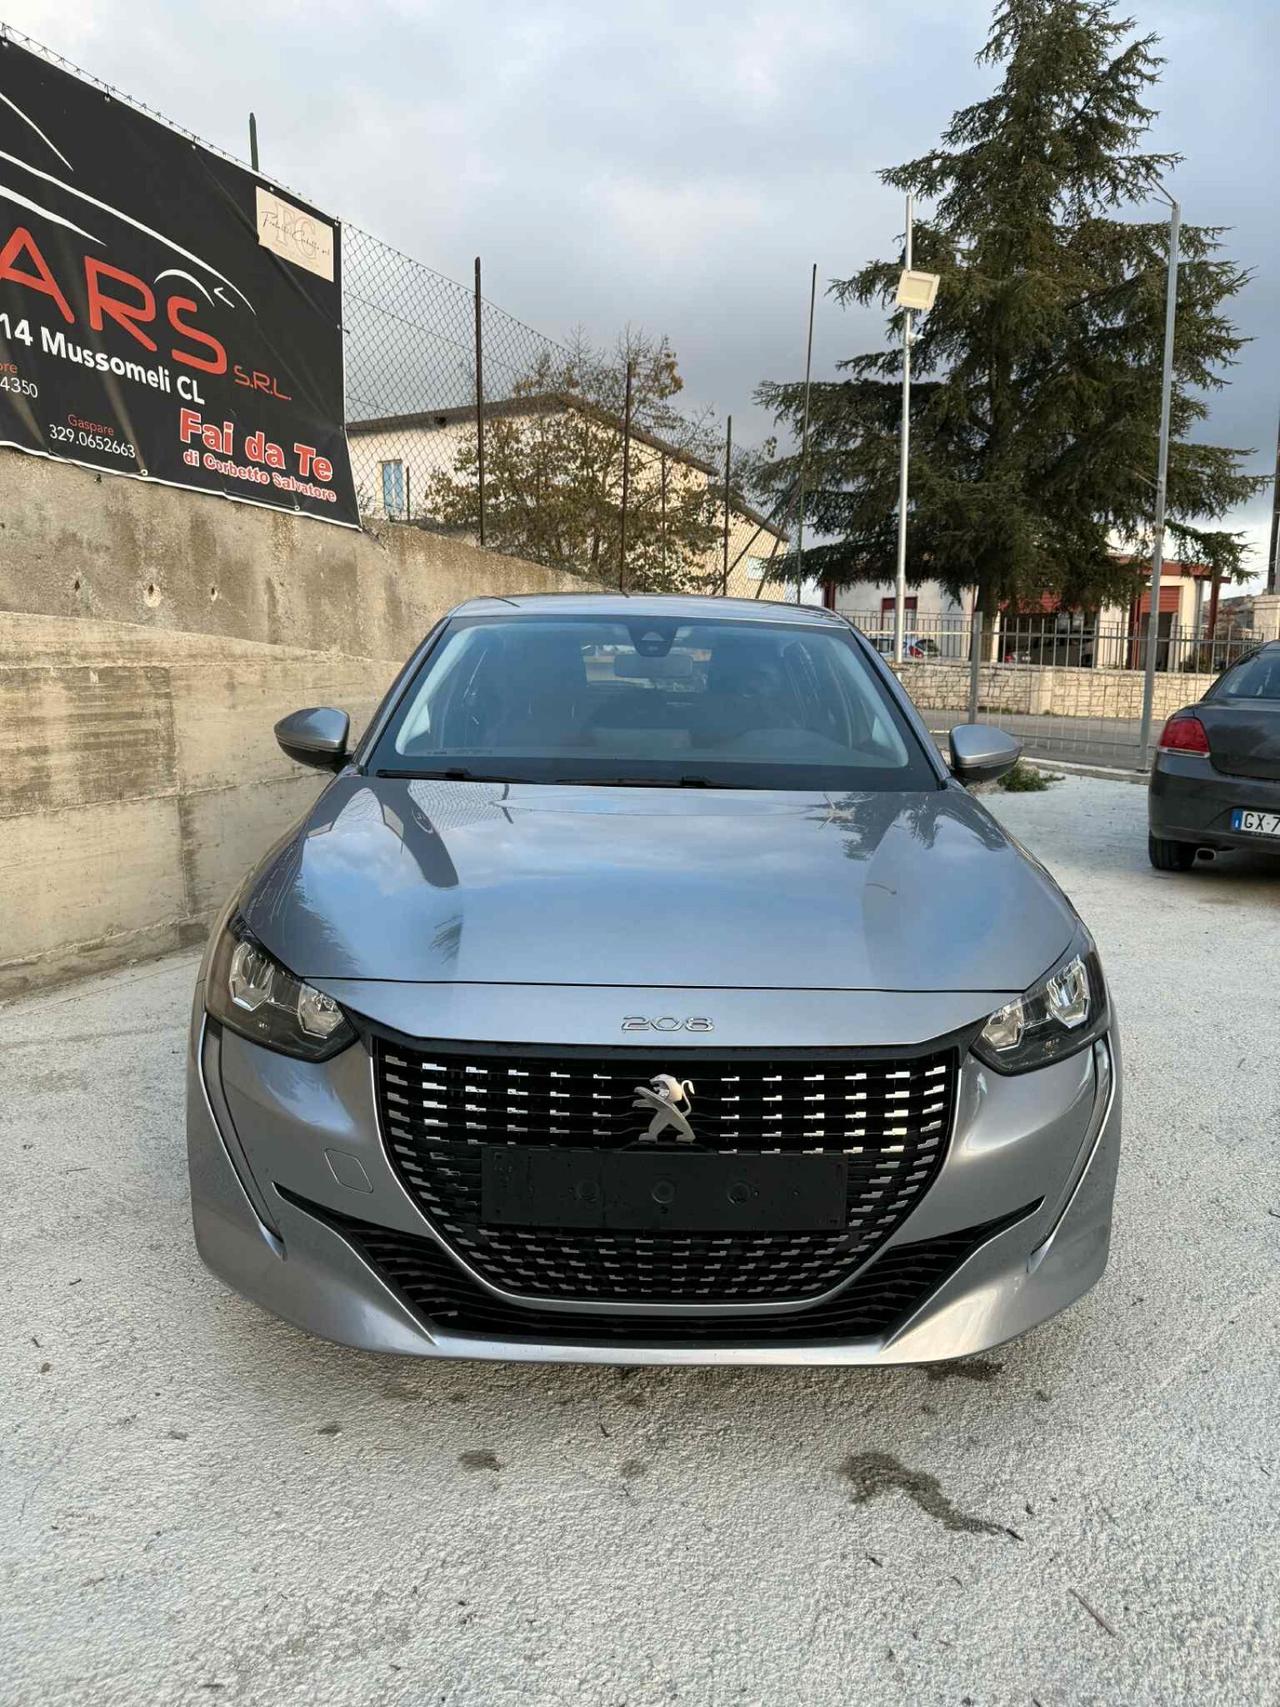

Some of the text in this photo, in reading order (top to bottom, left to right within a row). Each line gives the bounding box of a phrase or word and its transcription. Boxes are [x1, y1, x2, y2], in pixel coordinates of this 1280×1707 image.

[41, 326, 171, 392] Mussomeli
[177, 376, 205, 404] CL
[234, 365, 292, 400] S.R.L.
[50, 424, 136, 458] 329.0652663
[68, 414, 114, 436] Gaspare
[180, 408, 333, 481] Fai da Te
[183, 449, 337, 502] di Corbetto Salvatore
[621, 1016, 715, 1032] 208
